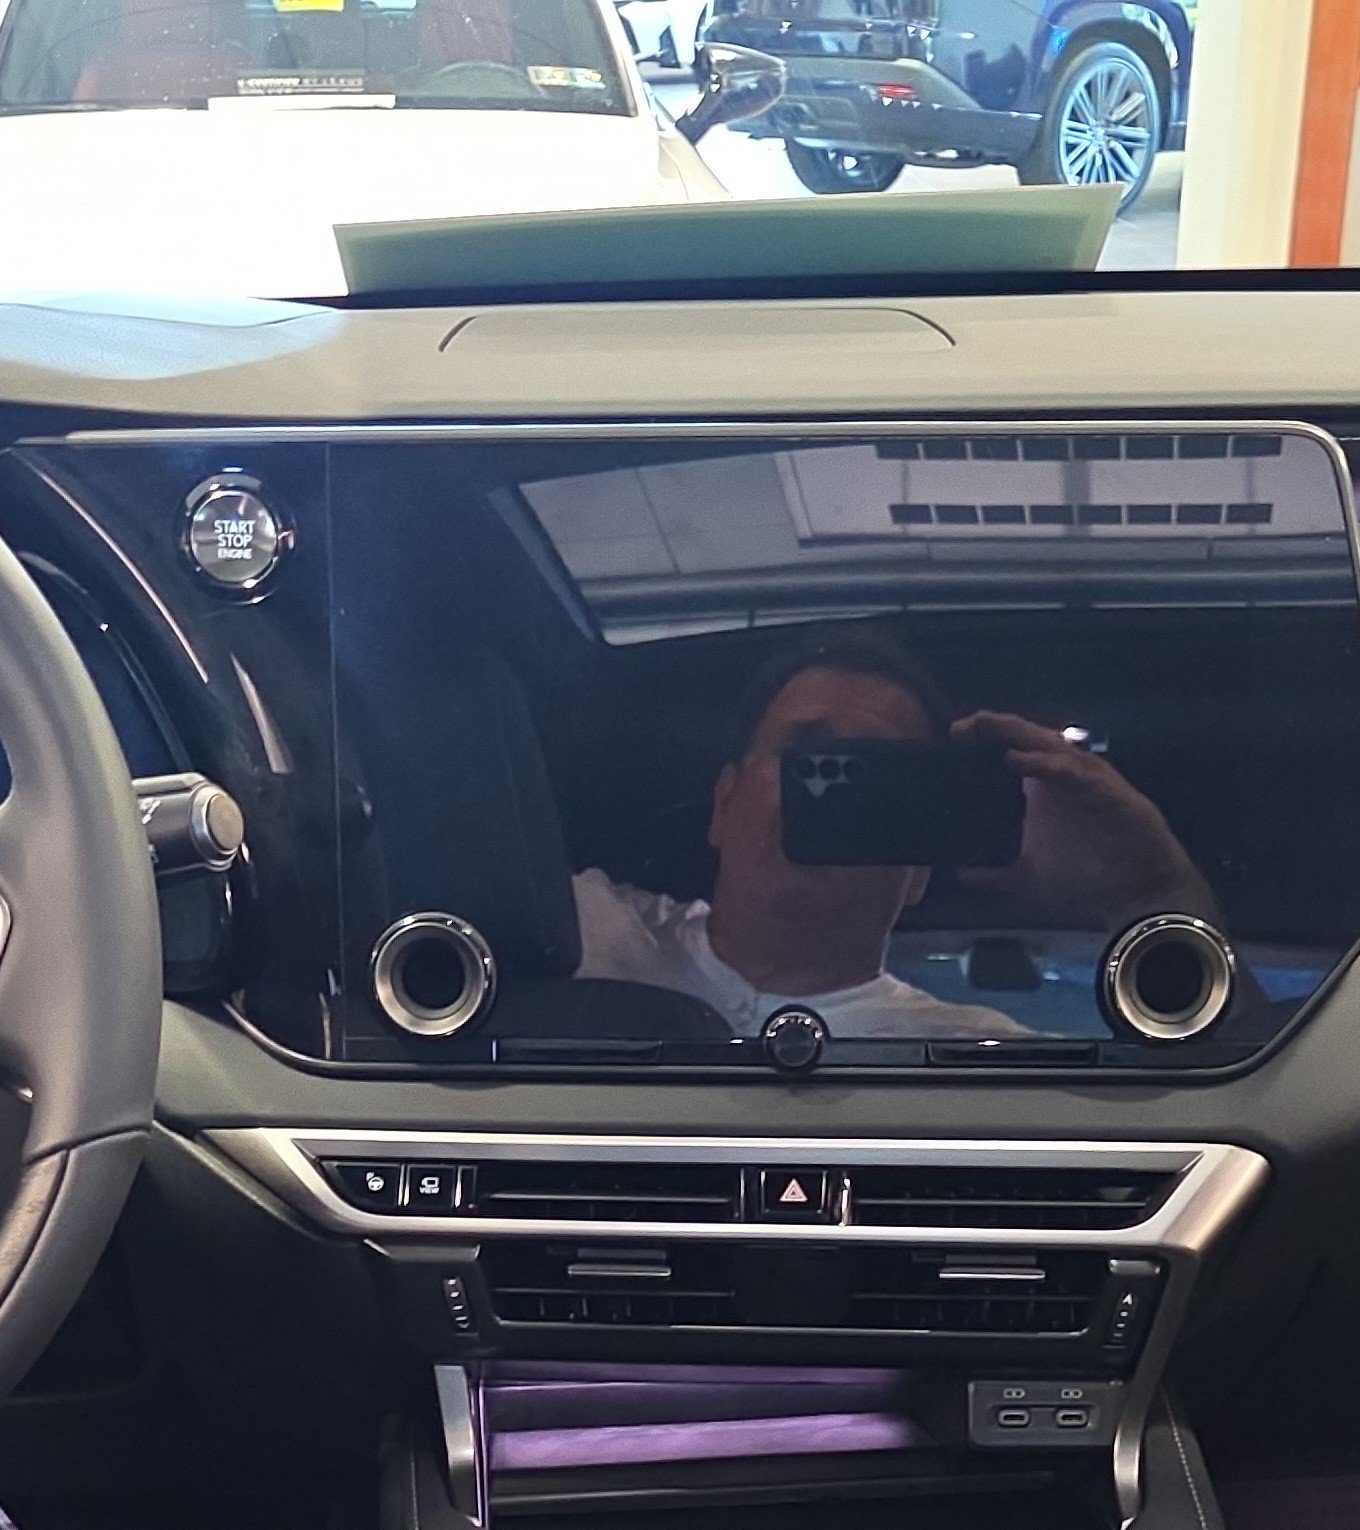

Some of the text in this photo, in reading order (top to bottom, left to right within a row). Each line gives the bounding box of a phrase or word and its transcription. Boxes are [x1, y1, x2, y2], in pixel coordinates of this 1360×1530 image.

[213, 519, 256, 534] START
[217, 533, 253, 548] STOP
[217, 547, 253, 559] ENGINE
